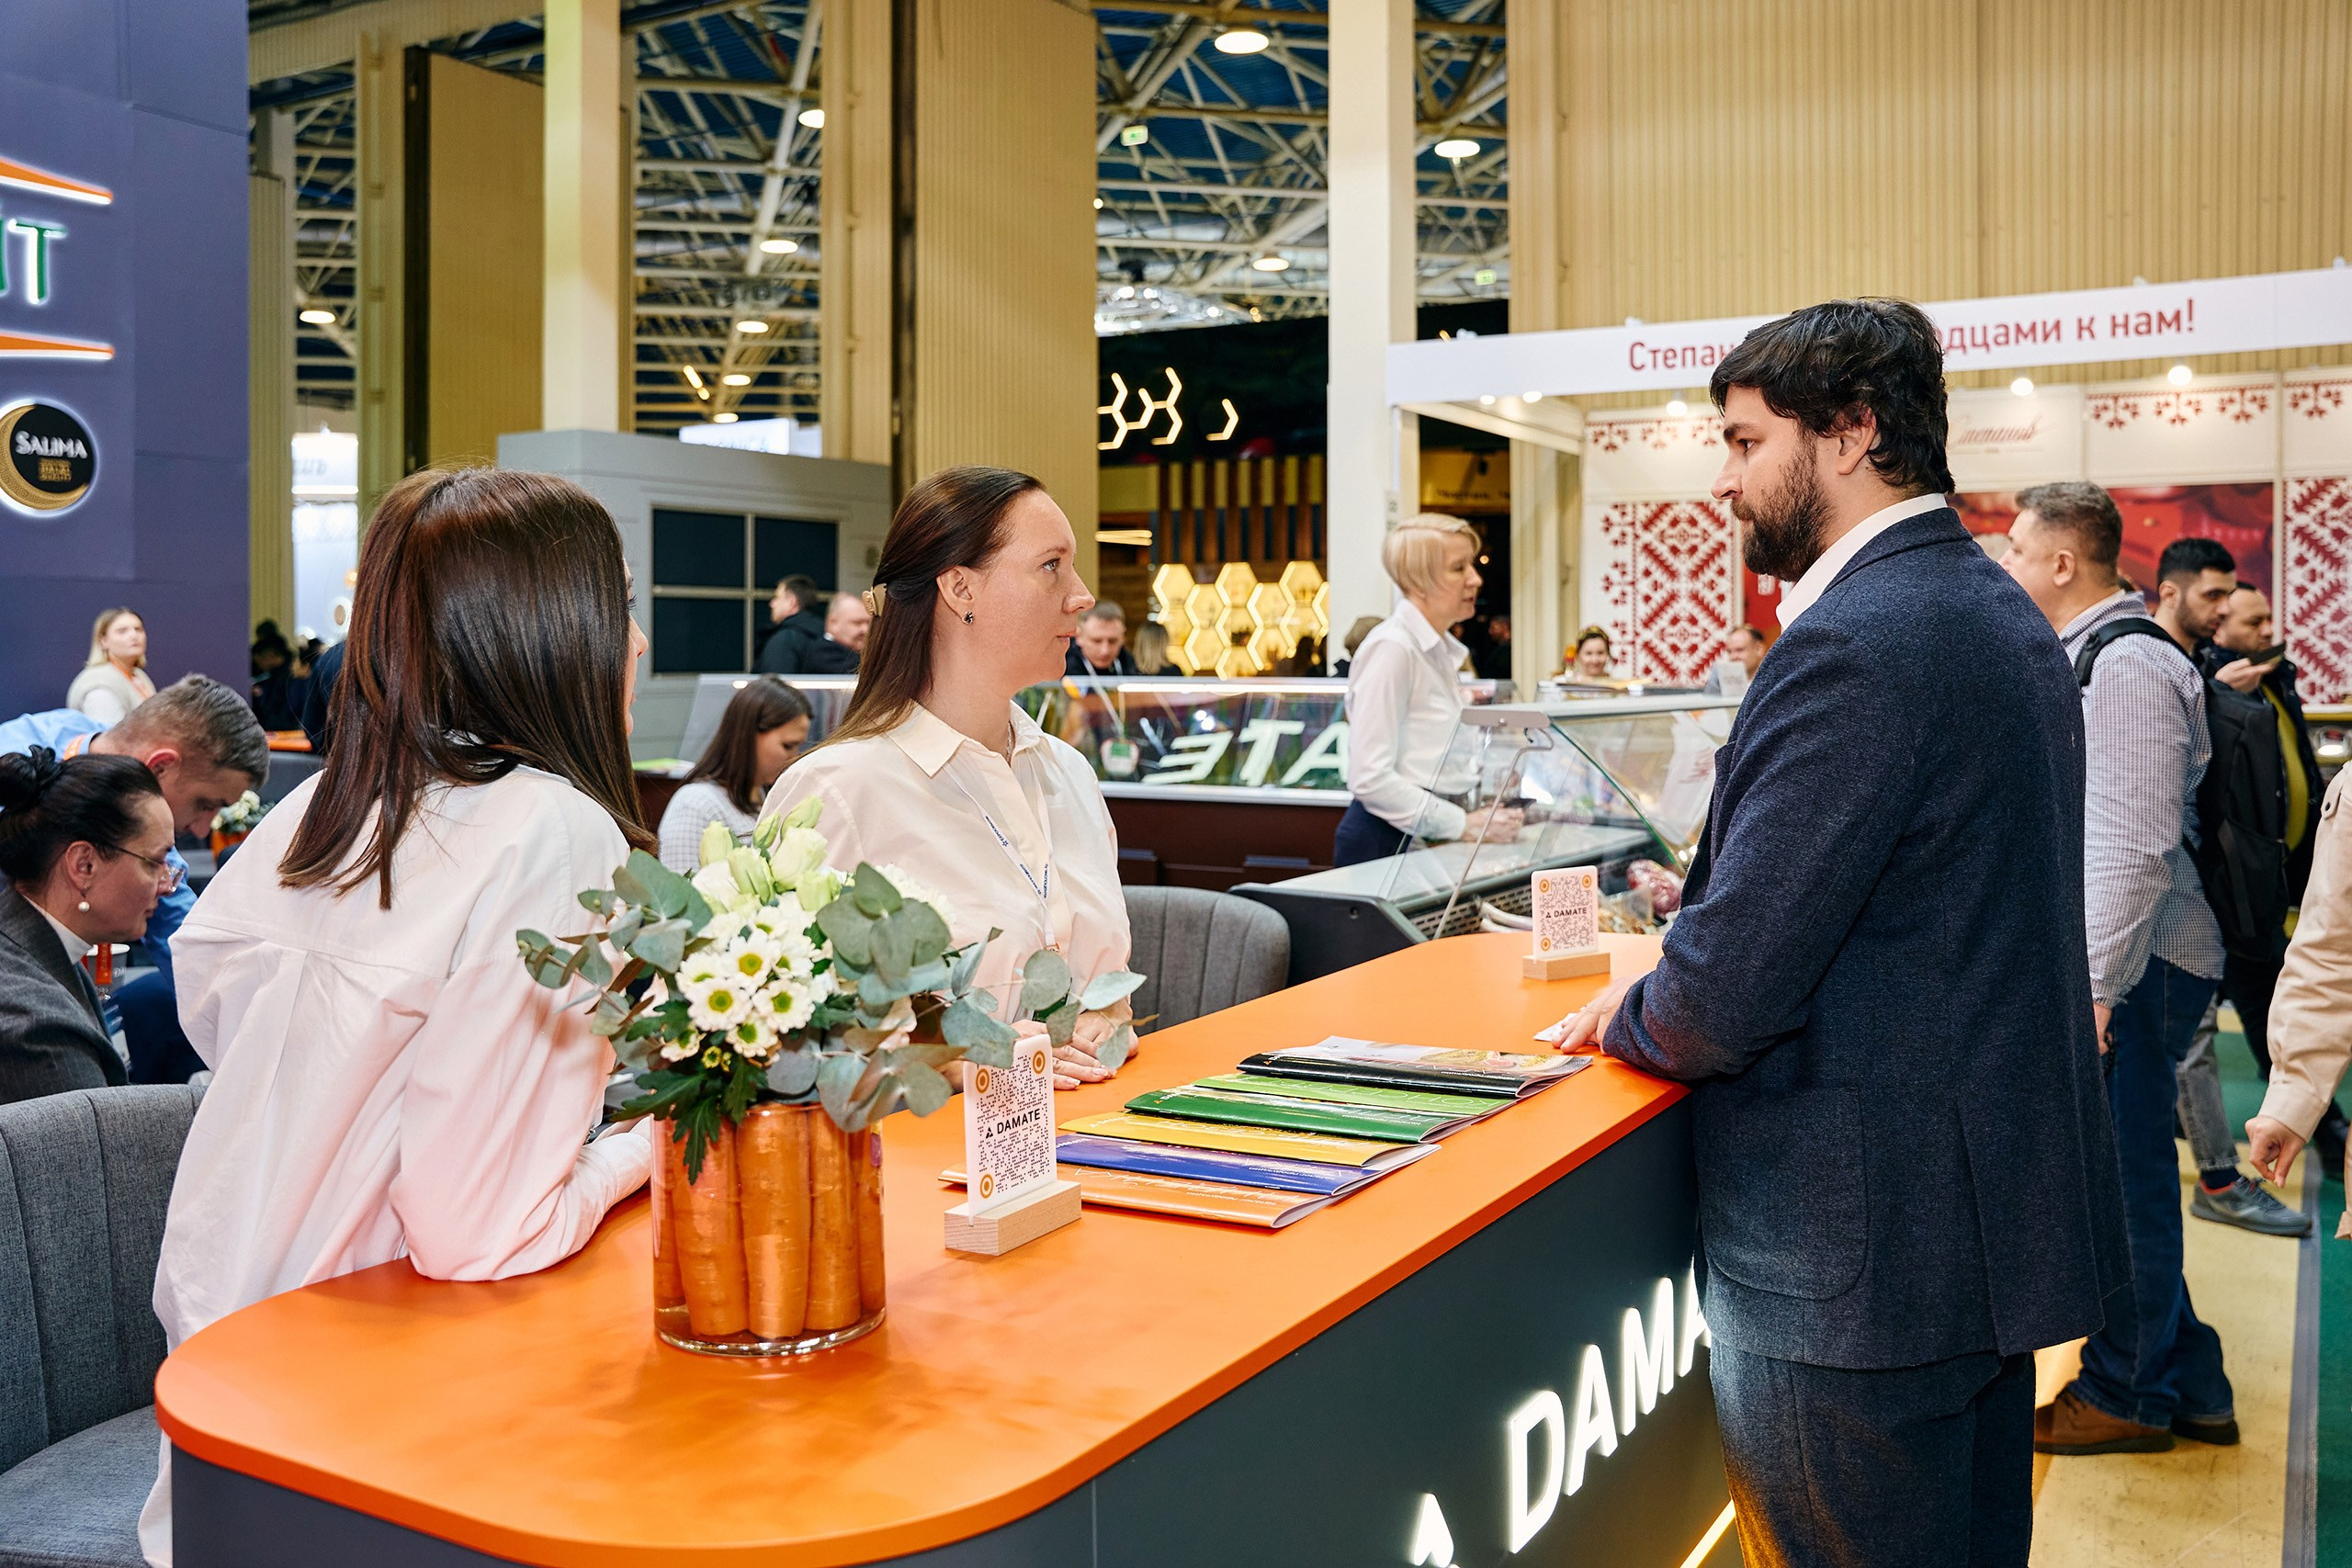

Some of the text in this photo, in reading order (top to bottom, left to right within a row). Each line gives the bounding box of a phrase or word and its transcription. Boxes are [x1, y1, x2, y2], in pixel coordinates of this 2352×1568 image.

[2076, 315, 2096, 340] к
[2110, 299, 2196, 339] нам!
[14, 431, 88, 459] SALIMA
[1554, 908, 1587, 918] DAMATE
[997, 1108, 1041, 1134] DAMATE
